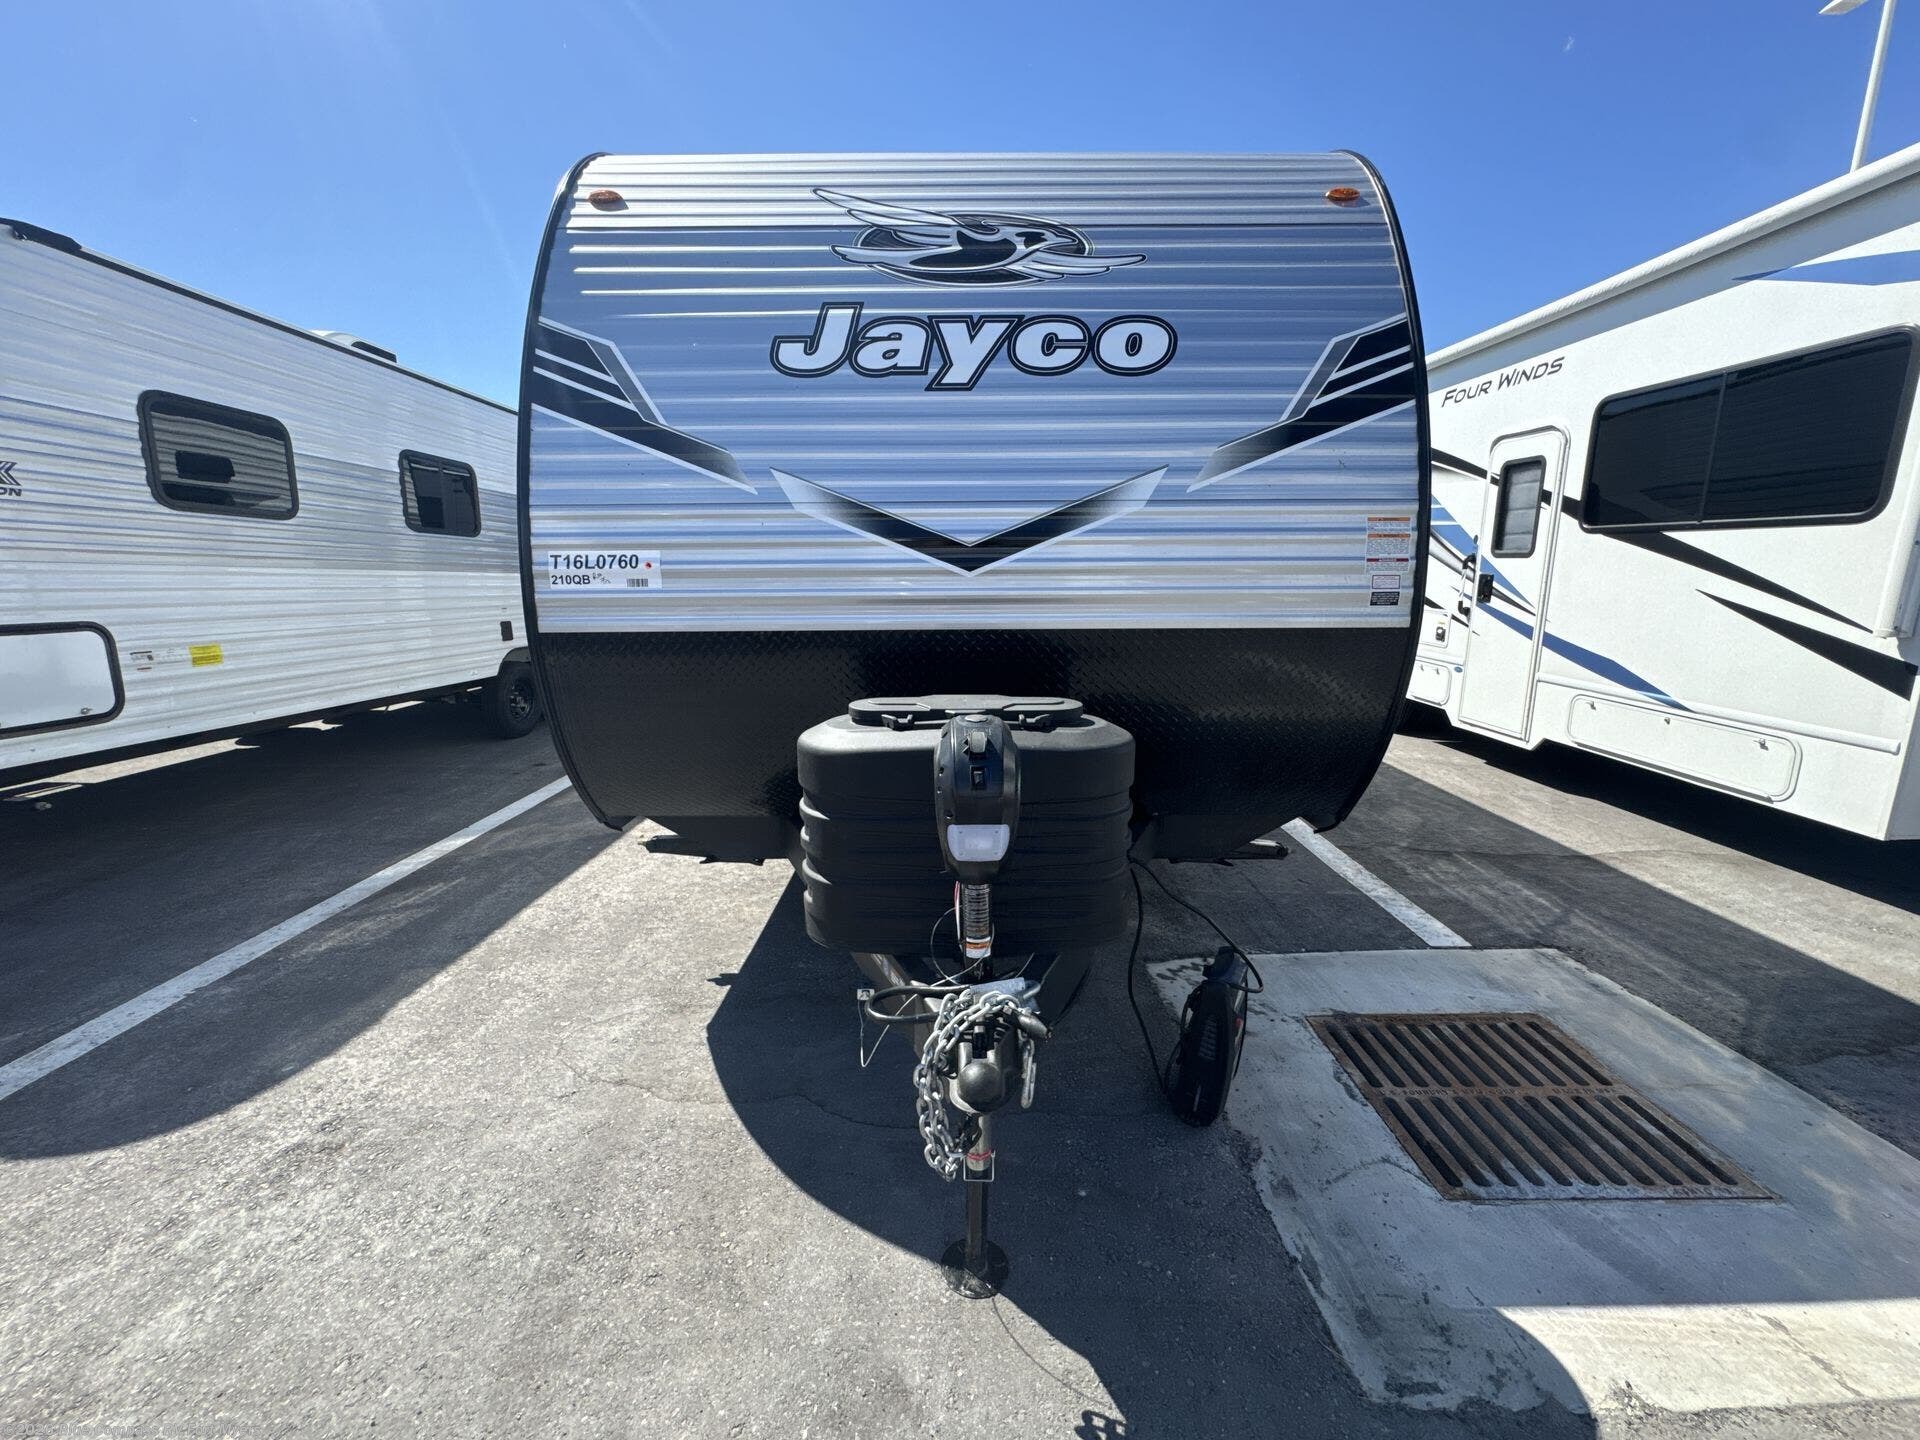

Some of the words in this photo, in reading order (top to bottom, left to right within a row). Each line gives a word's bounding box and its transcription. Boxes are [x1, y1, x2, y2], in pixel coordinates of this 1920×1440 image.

[769, 302, 1178, 392] Jayco
[1441, 380, 1493, 408] FOUR
[1498, 356, 1565, 391] WINDS
[550, 554, 639, 570] T16L0760
[551, 574, 591, 585] 210QB
